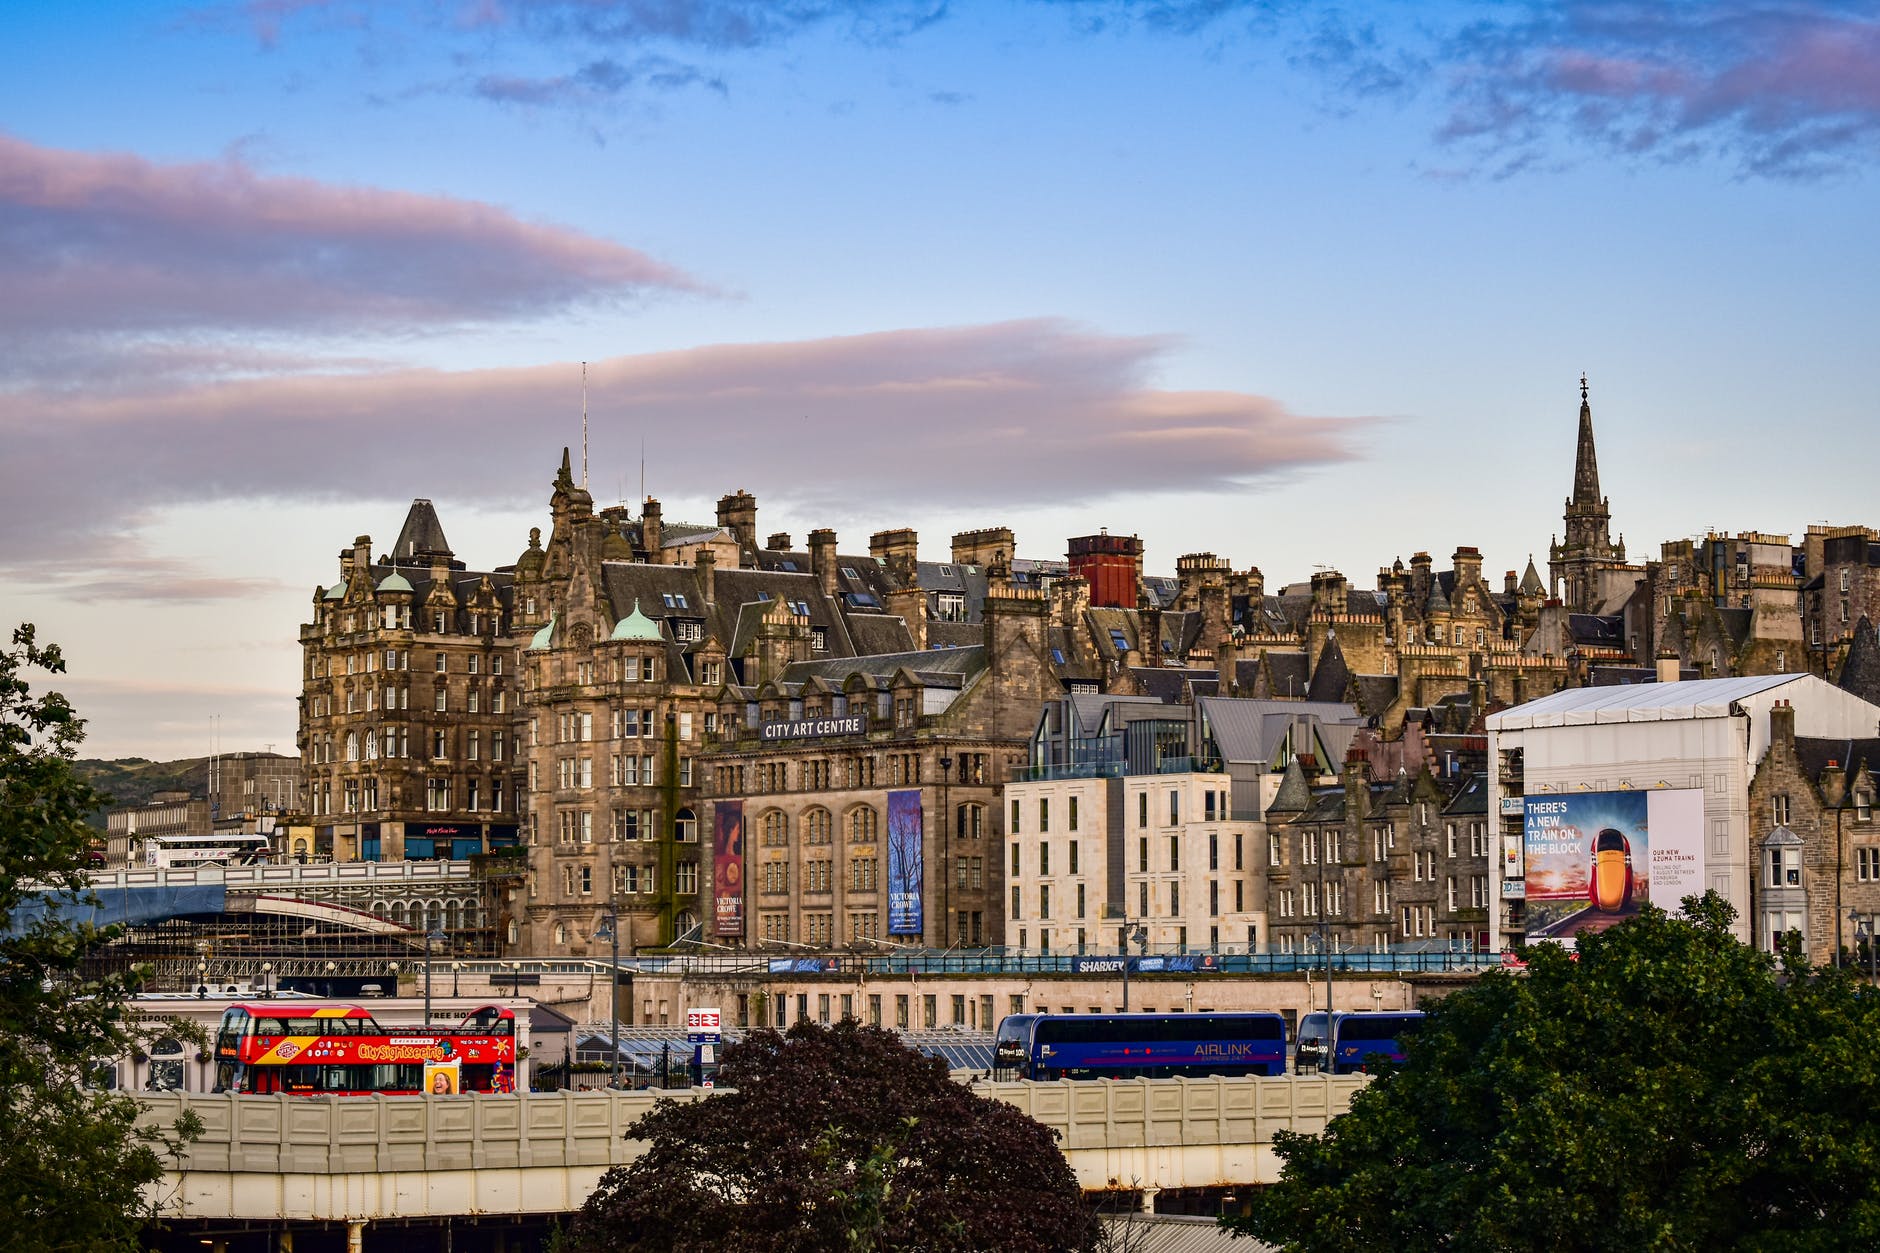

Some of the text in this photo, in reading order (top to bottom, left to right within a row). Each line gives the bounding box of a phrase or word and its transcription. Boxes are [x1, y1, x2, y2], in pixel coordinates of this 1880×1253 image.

[765, 718, 859, 738] CITY ART CENTRE
[1527, 802, 1567, 814] THERE'S
[1528, 816, 1560, 828] A NEW
[1528, 829, 1575, 841] TRAIN ON
[1528, 842, 1581, 855] THE BLOCK
[891, 901, 913, 909] CROWE
[1079, 961, 1125, 973] SHARKEY
[1194, 1043, 1252, 1056] AIRLINK
